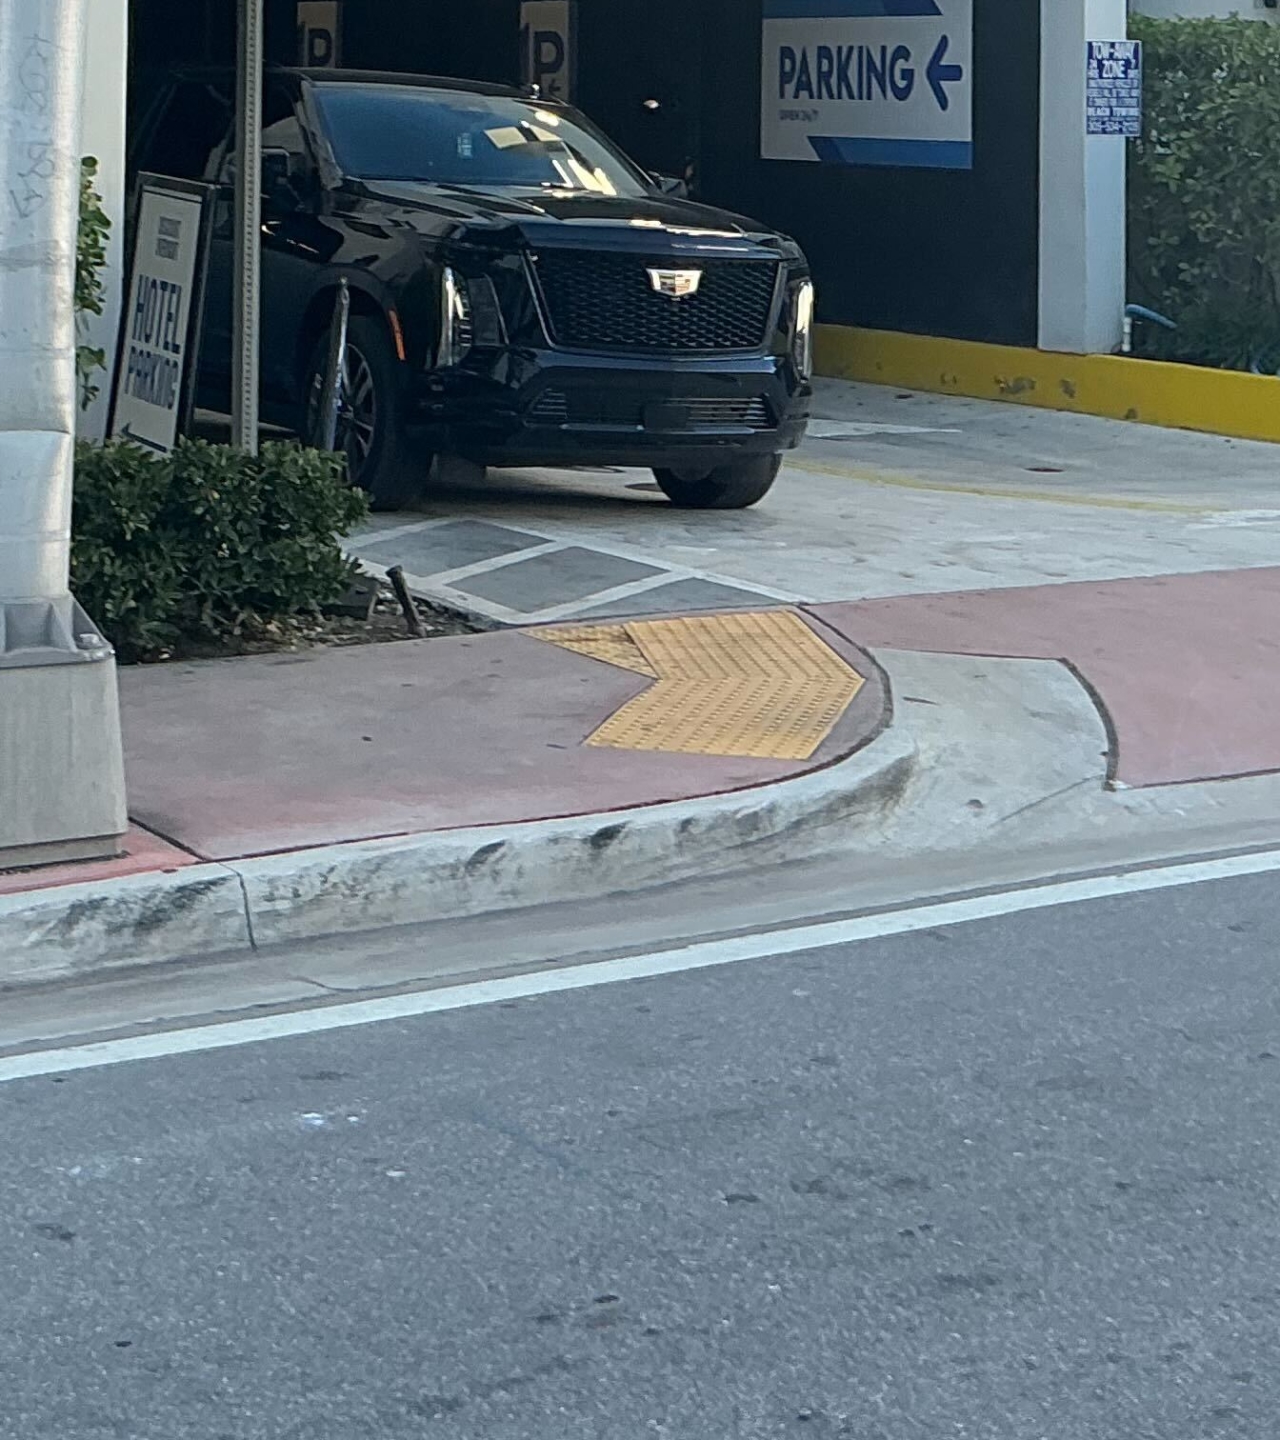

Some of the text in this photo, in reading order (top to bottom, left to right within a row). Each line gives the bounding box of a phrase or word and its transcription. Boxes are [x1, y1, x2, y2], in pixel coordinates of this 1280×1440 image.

[779, 45, 915, 101] PARKING
[1102, 60, 1126, 78] ZONE
[133, 274, 183, 354] HOTEL
[125, 346, 179, 410] PARKING
